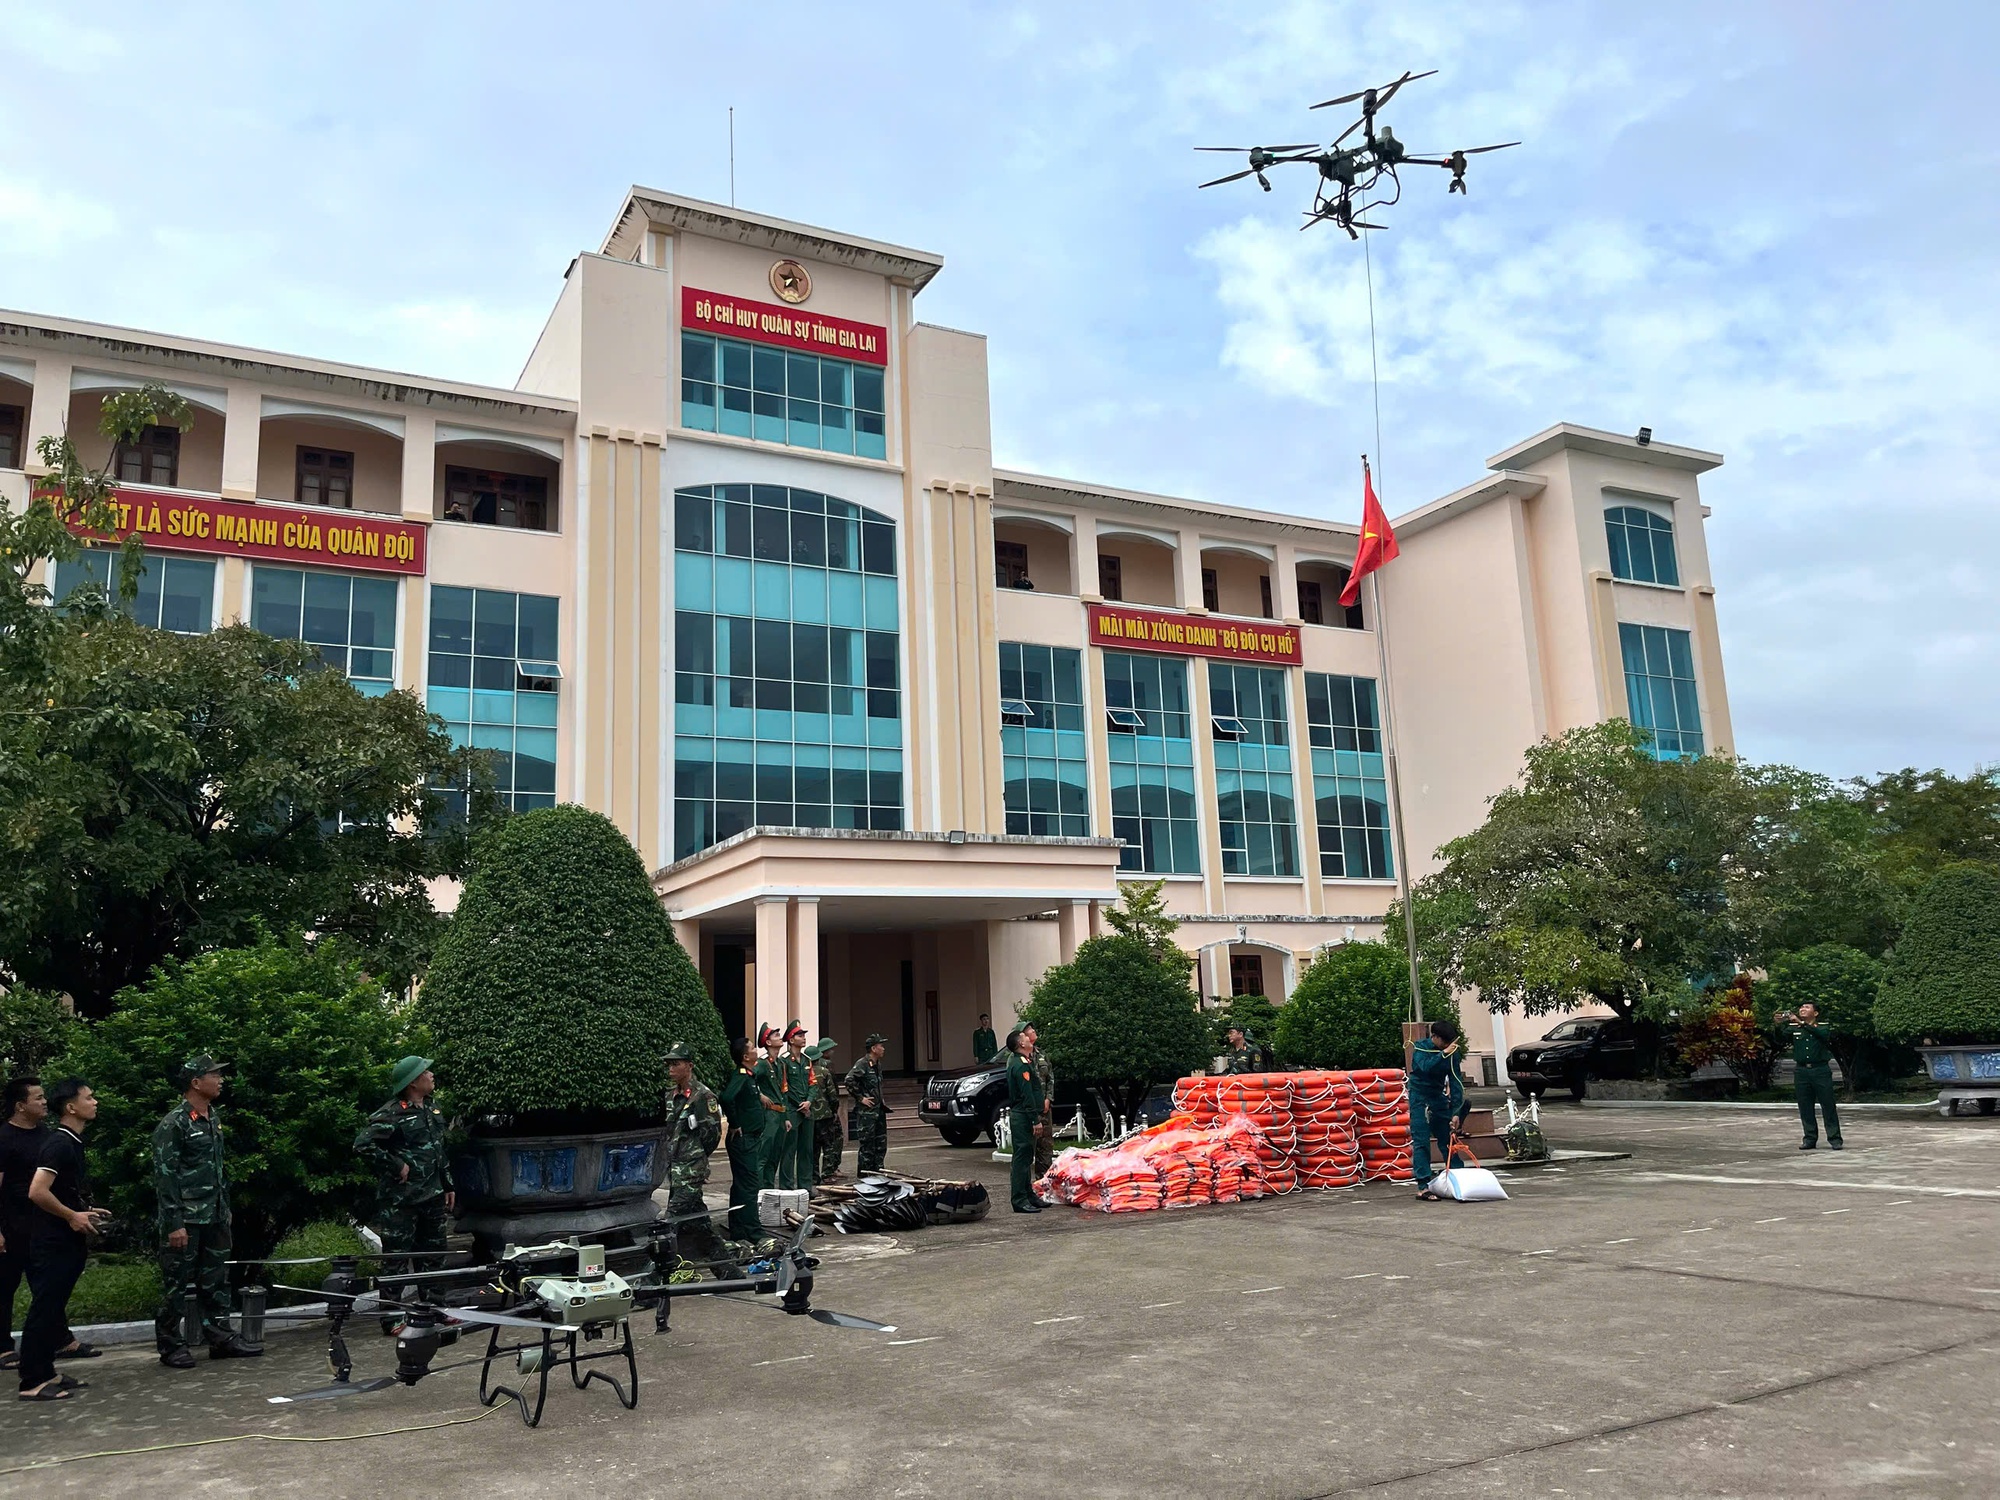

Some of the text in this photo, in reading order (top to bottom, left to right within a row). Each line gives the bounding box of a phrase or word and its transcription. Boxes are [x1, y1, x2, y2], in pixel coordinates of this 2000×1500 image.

[695, 299, 877, 353] BỘ CHỈ HUY QUÂN SỰ TỈNH GIA LAI
[135, 501, 162, 534] LÀ
[167, 504, 210, 539] SỨC
[215, 514, 278, 548] MẠNH
[283, 514, 323, 552] CỦA
[327, 526, 380, 557] QUÂN
[384, 530, 416, 565] ĐỘI
[1099, 613, 1123, 638] MÃI
[1125, 616, 1149, 641] MÃI
[1151, 617, 1184, 645] XỨNG
[1186, 627, 1218, 648] DANH
[1240, 628, 1259, 655] ĐỘI
[1260, 633, 1276, 657] CỤ
